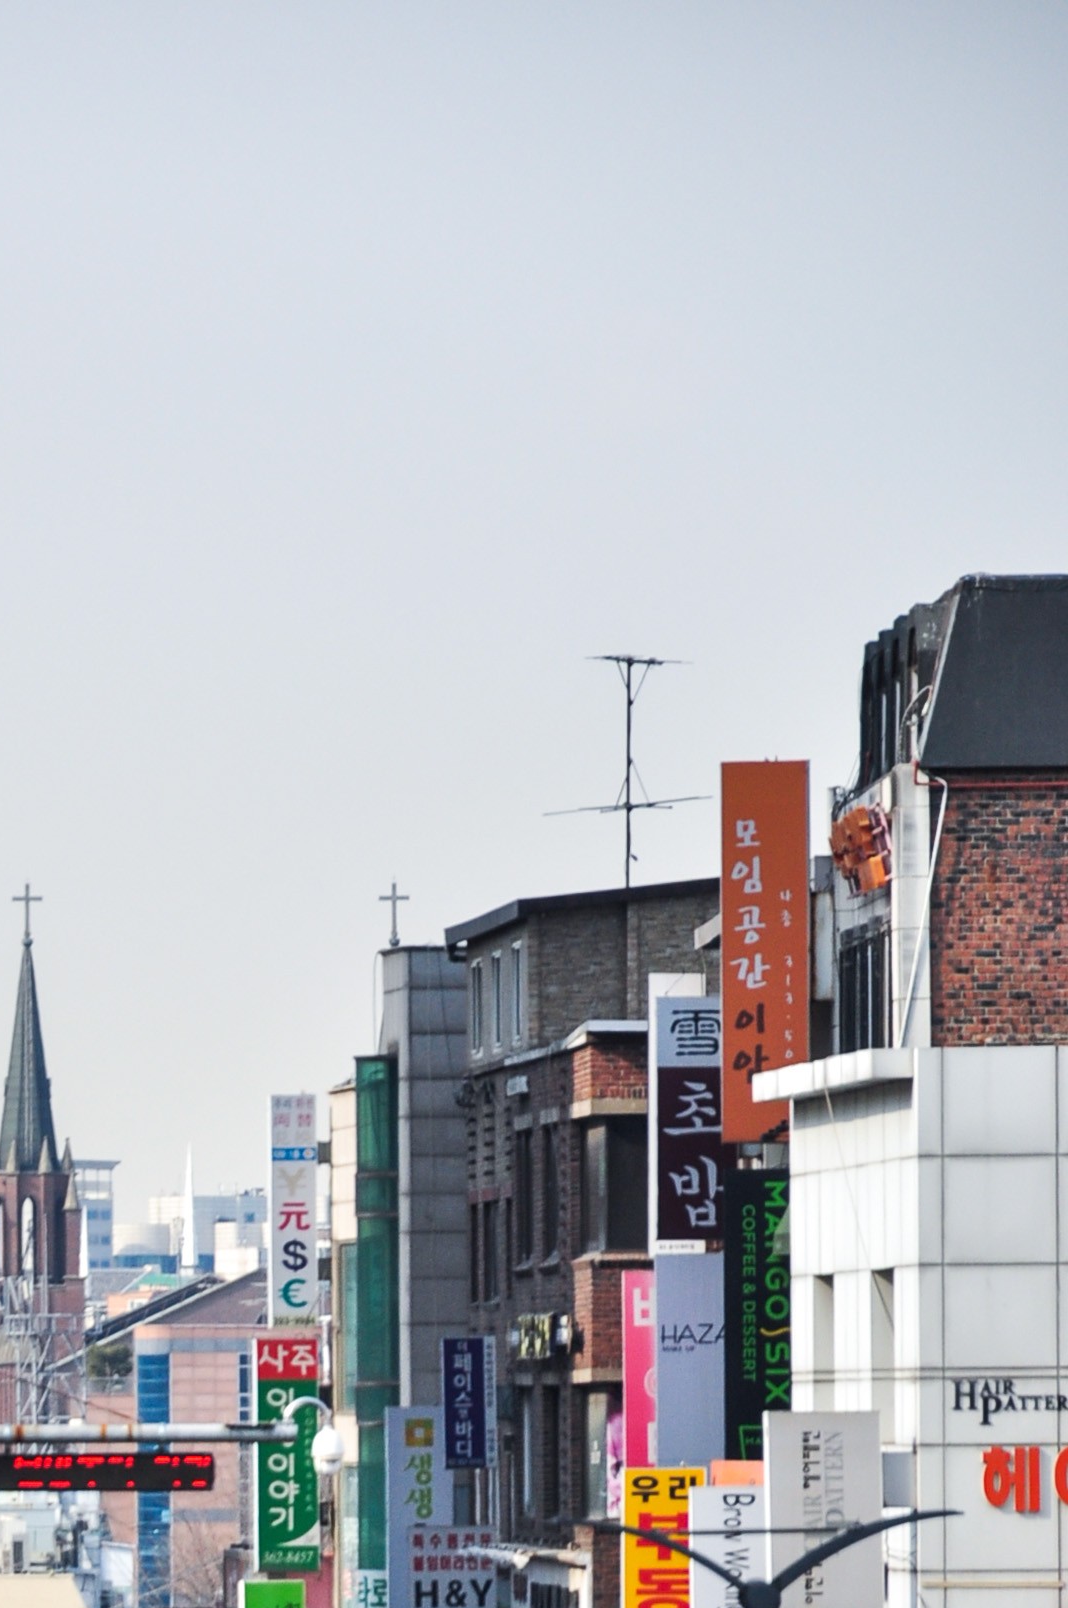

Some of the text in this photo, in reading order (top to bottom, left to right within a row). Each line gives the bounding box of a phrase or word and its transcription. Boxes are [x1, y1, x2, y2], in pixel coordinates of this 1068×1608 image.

[729, 818, 772, 989] 모임공간
[670, 1009, 722, 1056] 雪
[662, 1079, 725, 1230] 초밥
[742, 1204, 757, 1278] COFFEE
[258, 1344, 317, 1376] 사주
[742, 1300, 757, 1383] DESSERT
[764, 1341, 790, 1404] SIX
[952, 1378, 1016, 1411] HAIR
[266, 1386, 302, 1532] 인이야기
[631, 1477, 697, 1503] 우리
[413, 1578, 494, 1608] H&Y
